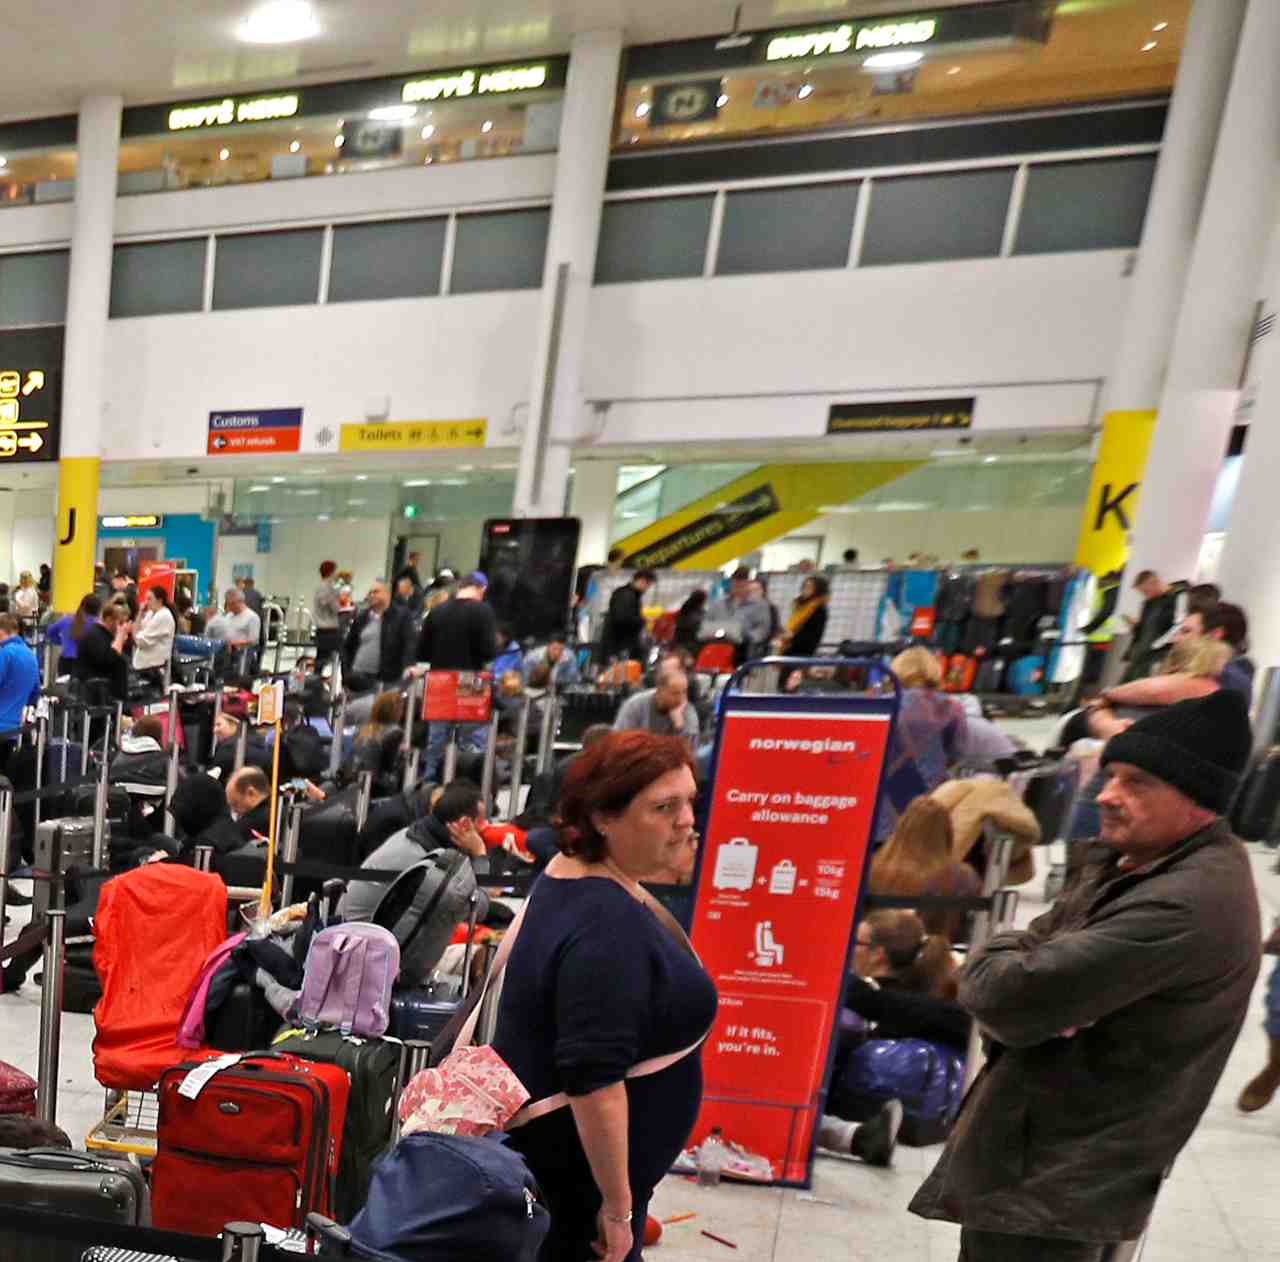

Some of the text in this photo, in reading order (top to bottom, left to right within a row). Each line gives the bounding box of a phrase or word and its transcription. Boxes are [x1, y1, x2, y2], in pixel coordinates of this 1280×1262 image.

[213, 416, 260, 427] Customs
[358, 427, 403, 441] Toilets
[1093, 481, 1140, 531] K
[59, 508, 76, 545] J
[748, 736, 856, 754] norwegian
[726, 788, 858, 811] Carry on baggage
[751, 809, 829, 825] allowance
[726, 1025, 777, 1042] If it fits,
[716, 1040, 780, 1057] you're in.
